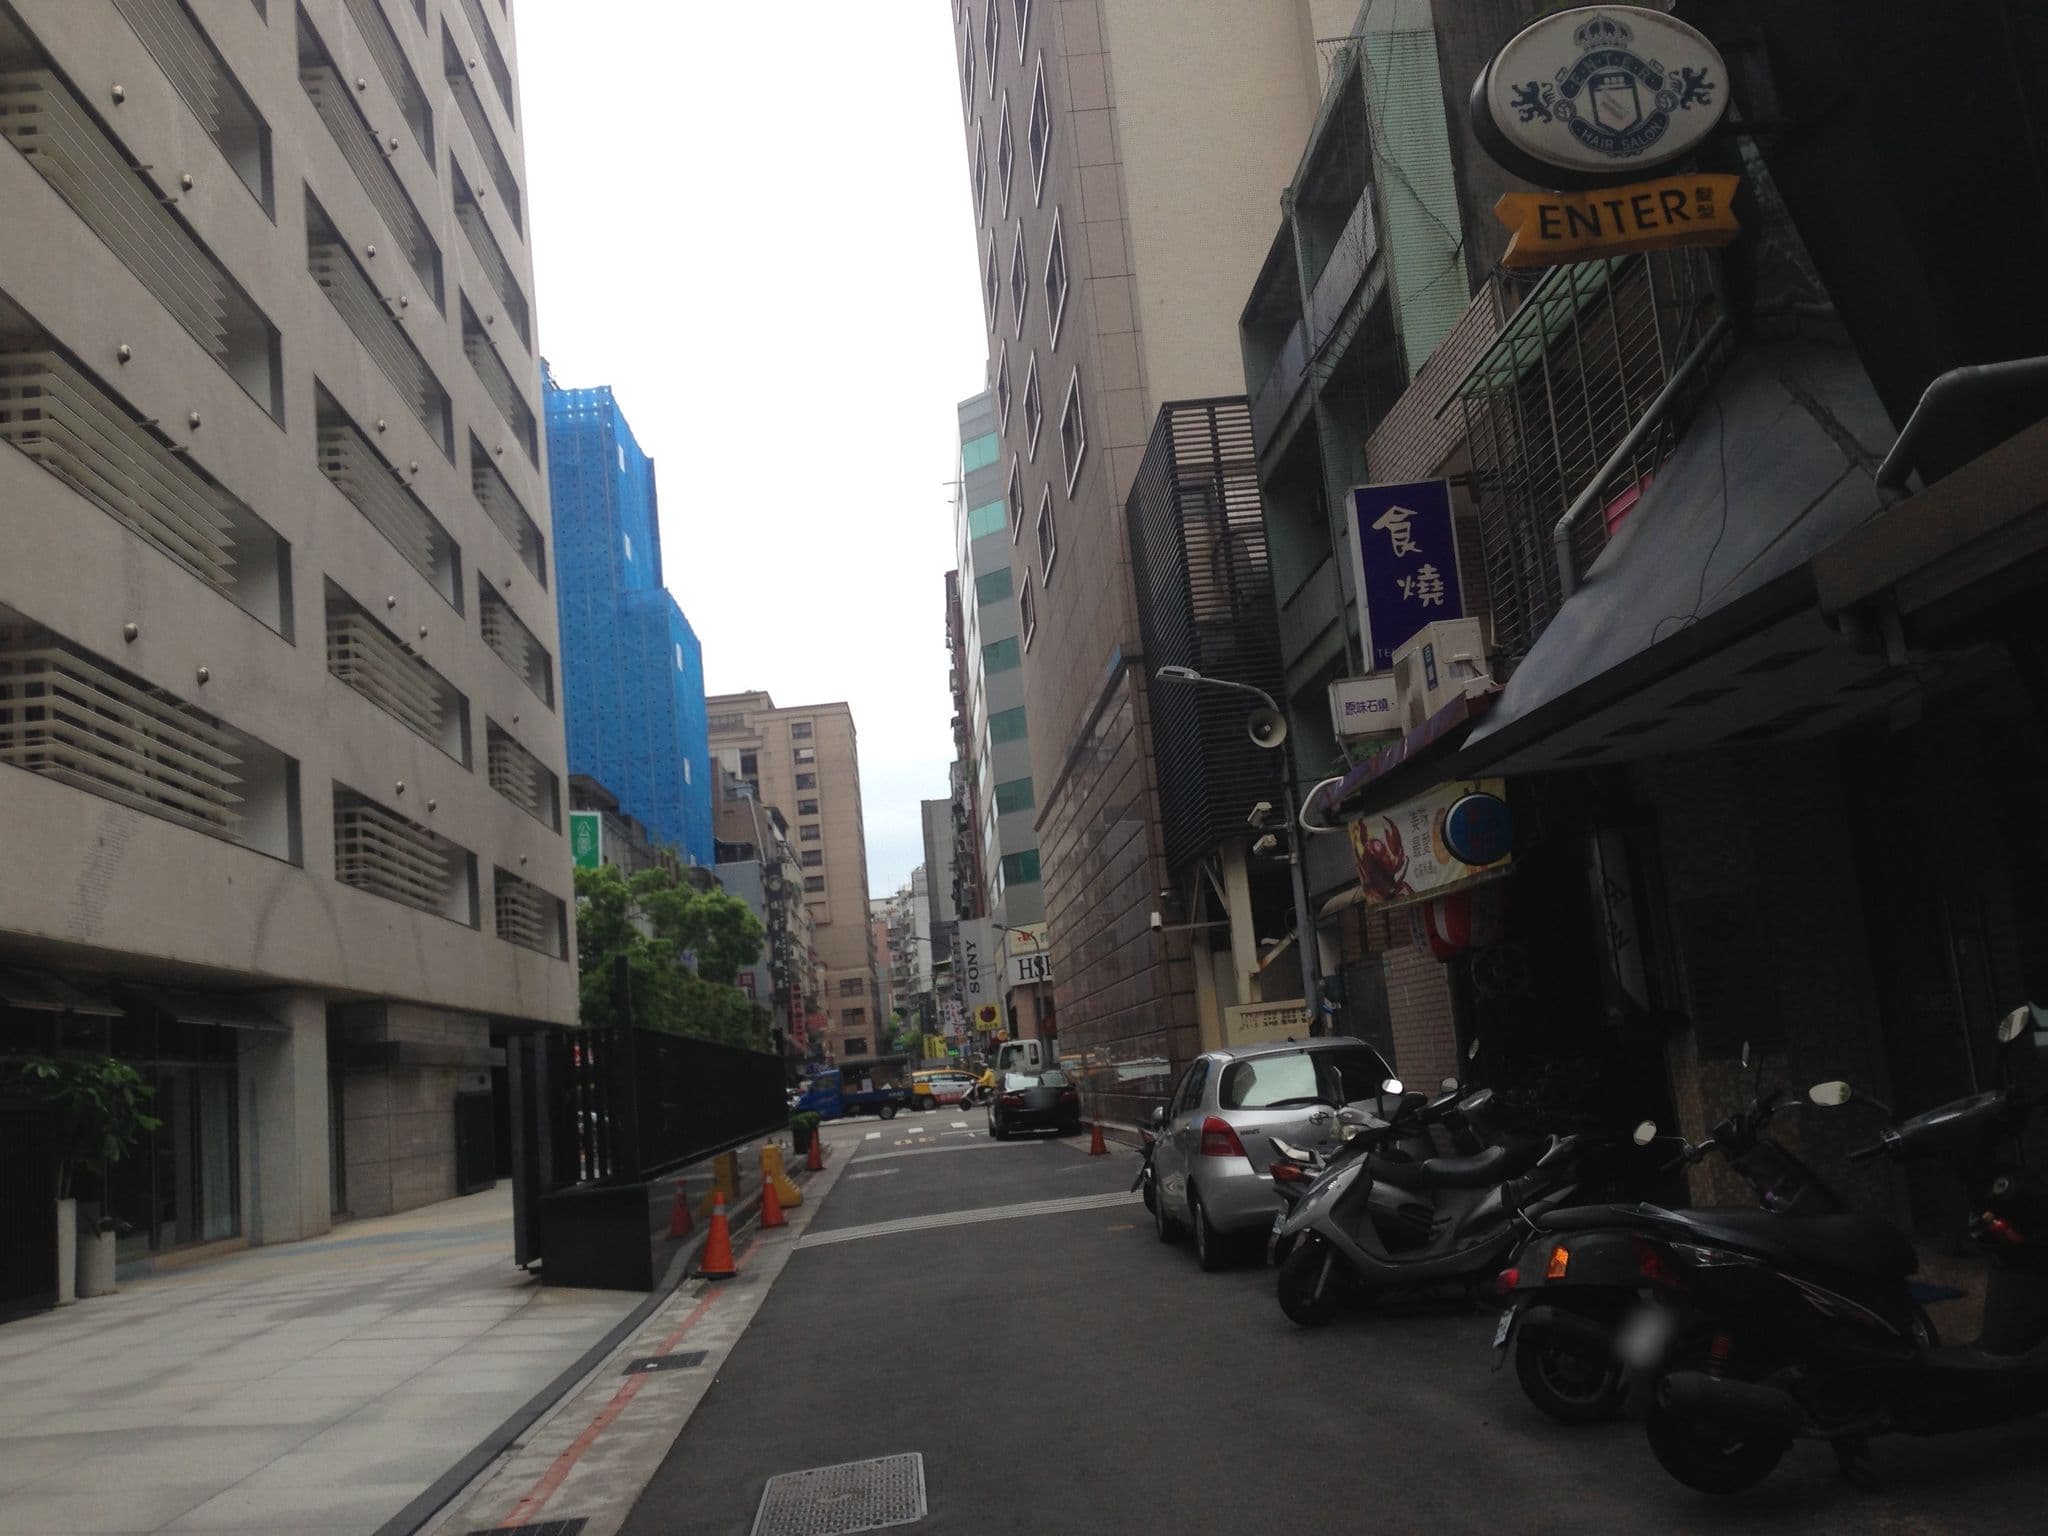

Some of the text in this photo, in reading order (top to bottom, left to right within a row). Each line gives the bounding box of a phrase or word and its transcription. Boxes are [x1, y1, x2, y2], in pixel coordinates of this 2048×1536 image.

[1581, 123, 1664, 150] HAIR SALON
[1539, 189, 1691, 240] ENTER
[1376, 648, 1395, 657] TE
[965, 940, 980, 994] SONY
